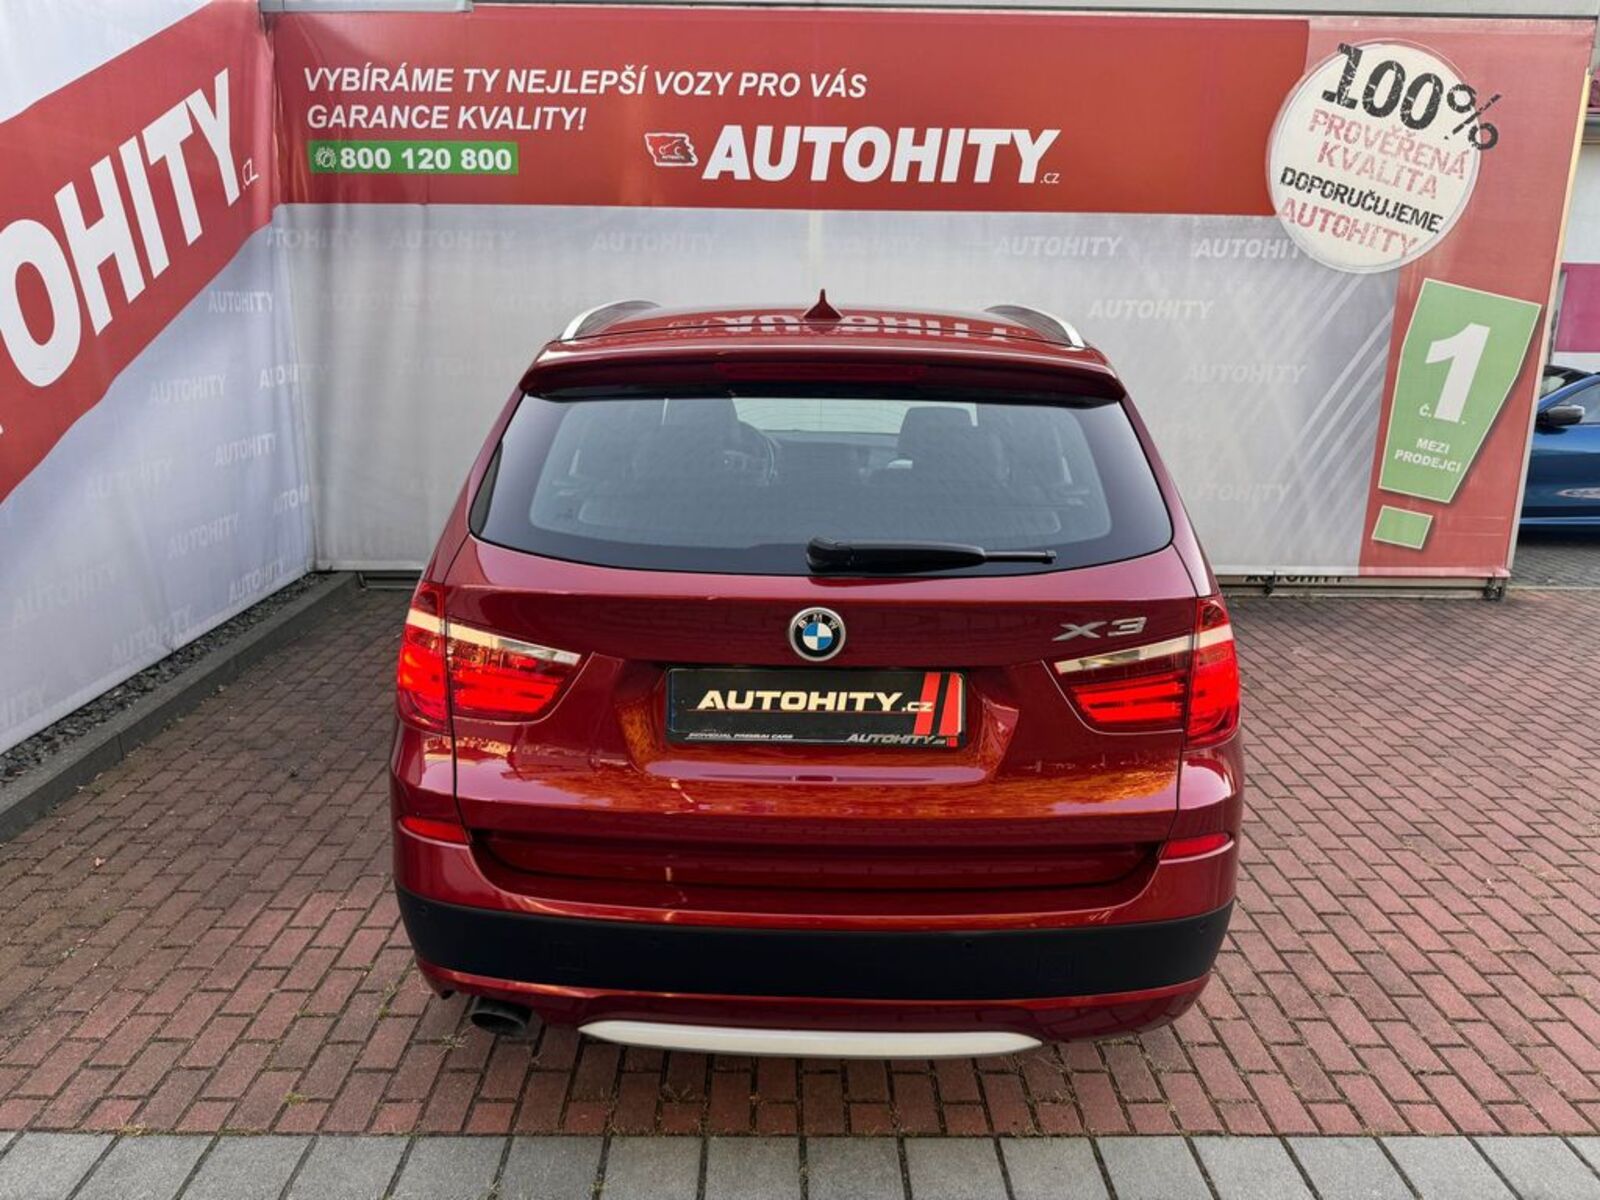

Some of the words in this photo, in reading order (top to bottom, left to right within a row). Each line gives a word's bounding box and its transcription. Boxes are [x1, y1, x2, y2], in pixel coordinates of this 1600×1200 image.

[304, 63, 454, 92] VYBÍRÁME
[463, 68, 500, 93] TY
[506, 65, 648, 96] NEJLEPŠÍ
[653, 72, 733, 97] VOZY
[738, 74, 800, 98] PRO
[810, 68, 868, 98] VÁS
[1321, 43, 1503, 151] 100%
[307, 105, 449, 129] GARANCE
[457, 106, 588, 131] KVALITY!
[340, 148, 391, 170] 800
[401, 148, 451, 170] 120
[460, 148, 512, 171] 800
[1317, 141, 1439, 200] KVALITA
[1279, 166, 1444, 235] DOPORUČUJEME
[1280, 197, 1420, 258] AUTOHITY
[1194, 239, 1303, 259] AUTOHIT
[207, 290, 274, 313] AUTOHITY
[1416, 438, 1450, 455] MEZI
[1394, 449, 1462, 473] PRODEJCI
[1051, 616, 1147, 641] X3
